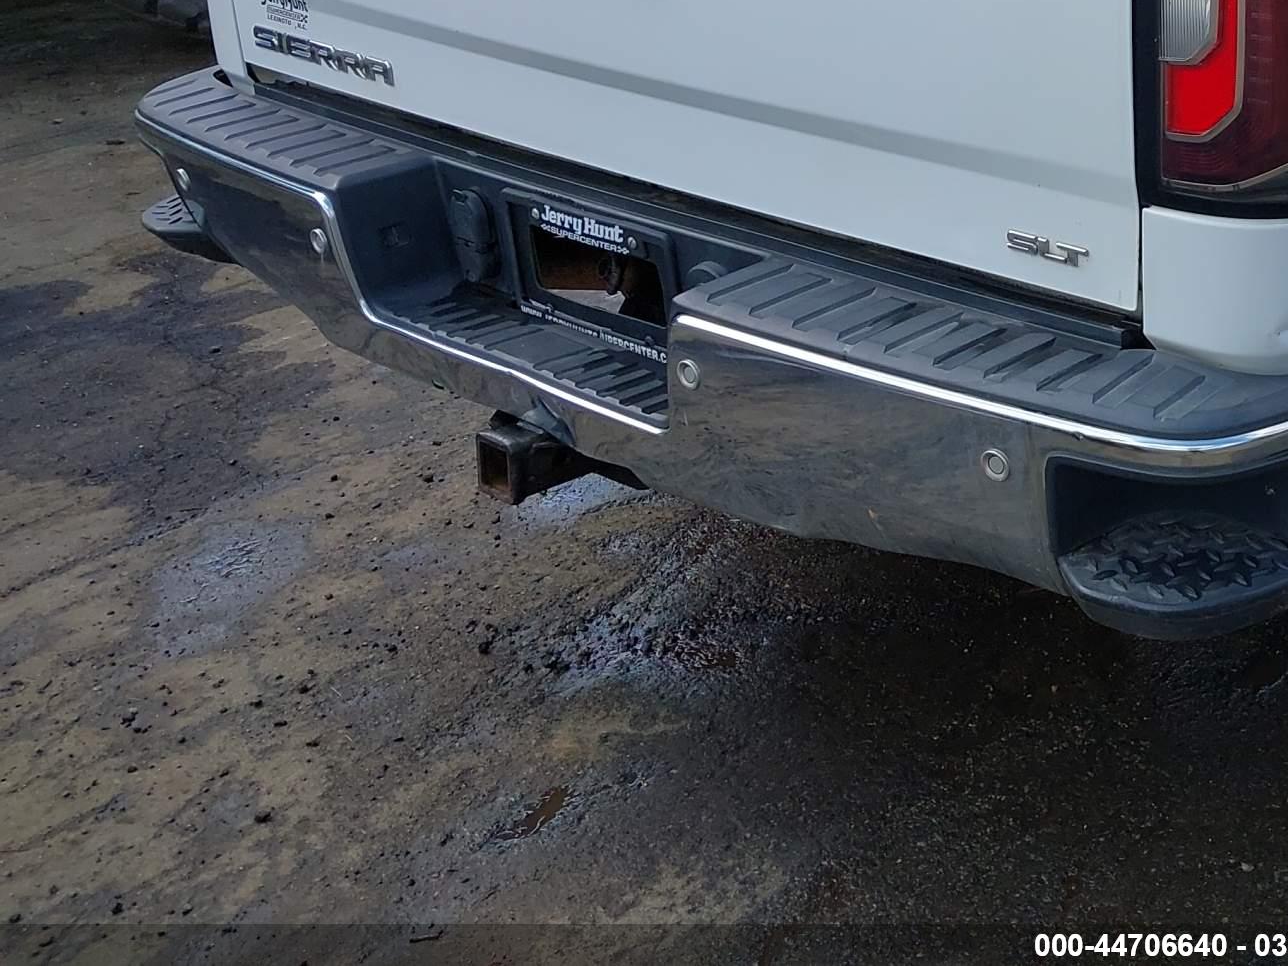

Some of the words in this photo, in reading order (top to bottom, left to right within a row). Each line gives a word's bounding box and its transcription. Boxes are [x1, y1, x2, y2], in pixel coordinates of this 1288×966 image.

[253, 25, 396, 87] SIERRA
[550, 227, 618, 252] SUPERCENTER
[1006, 228, 1090, 267] SLT
